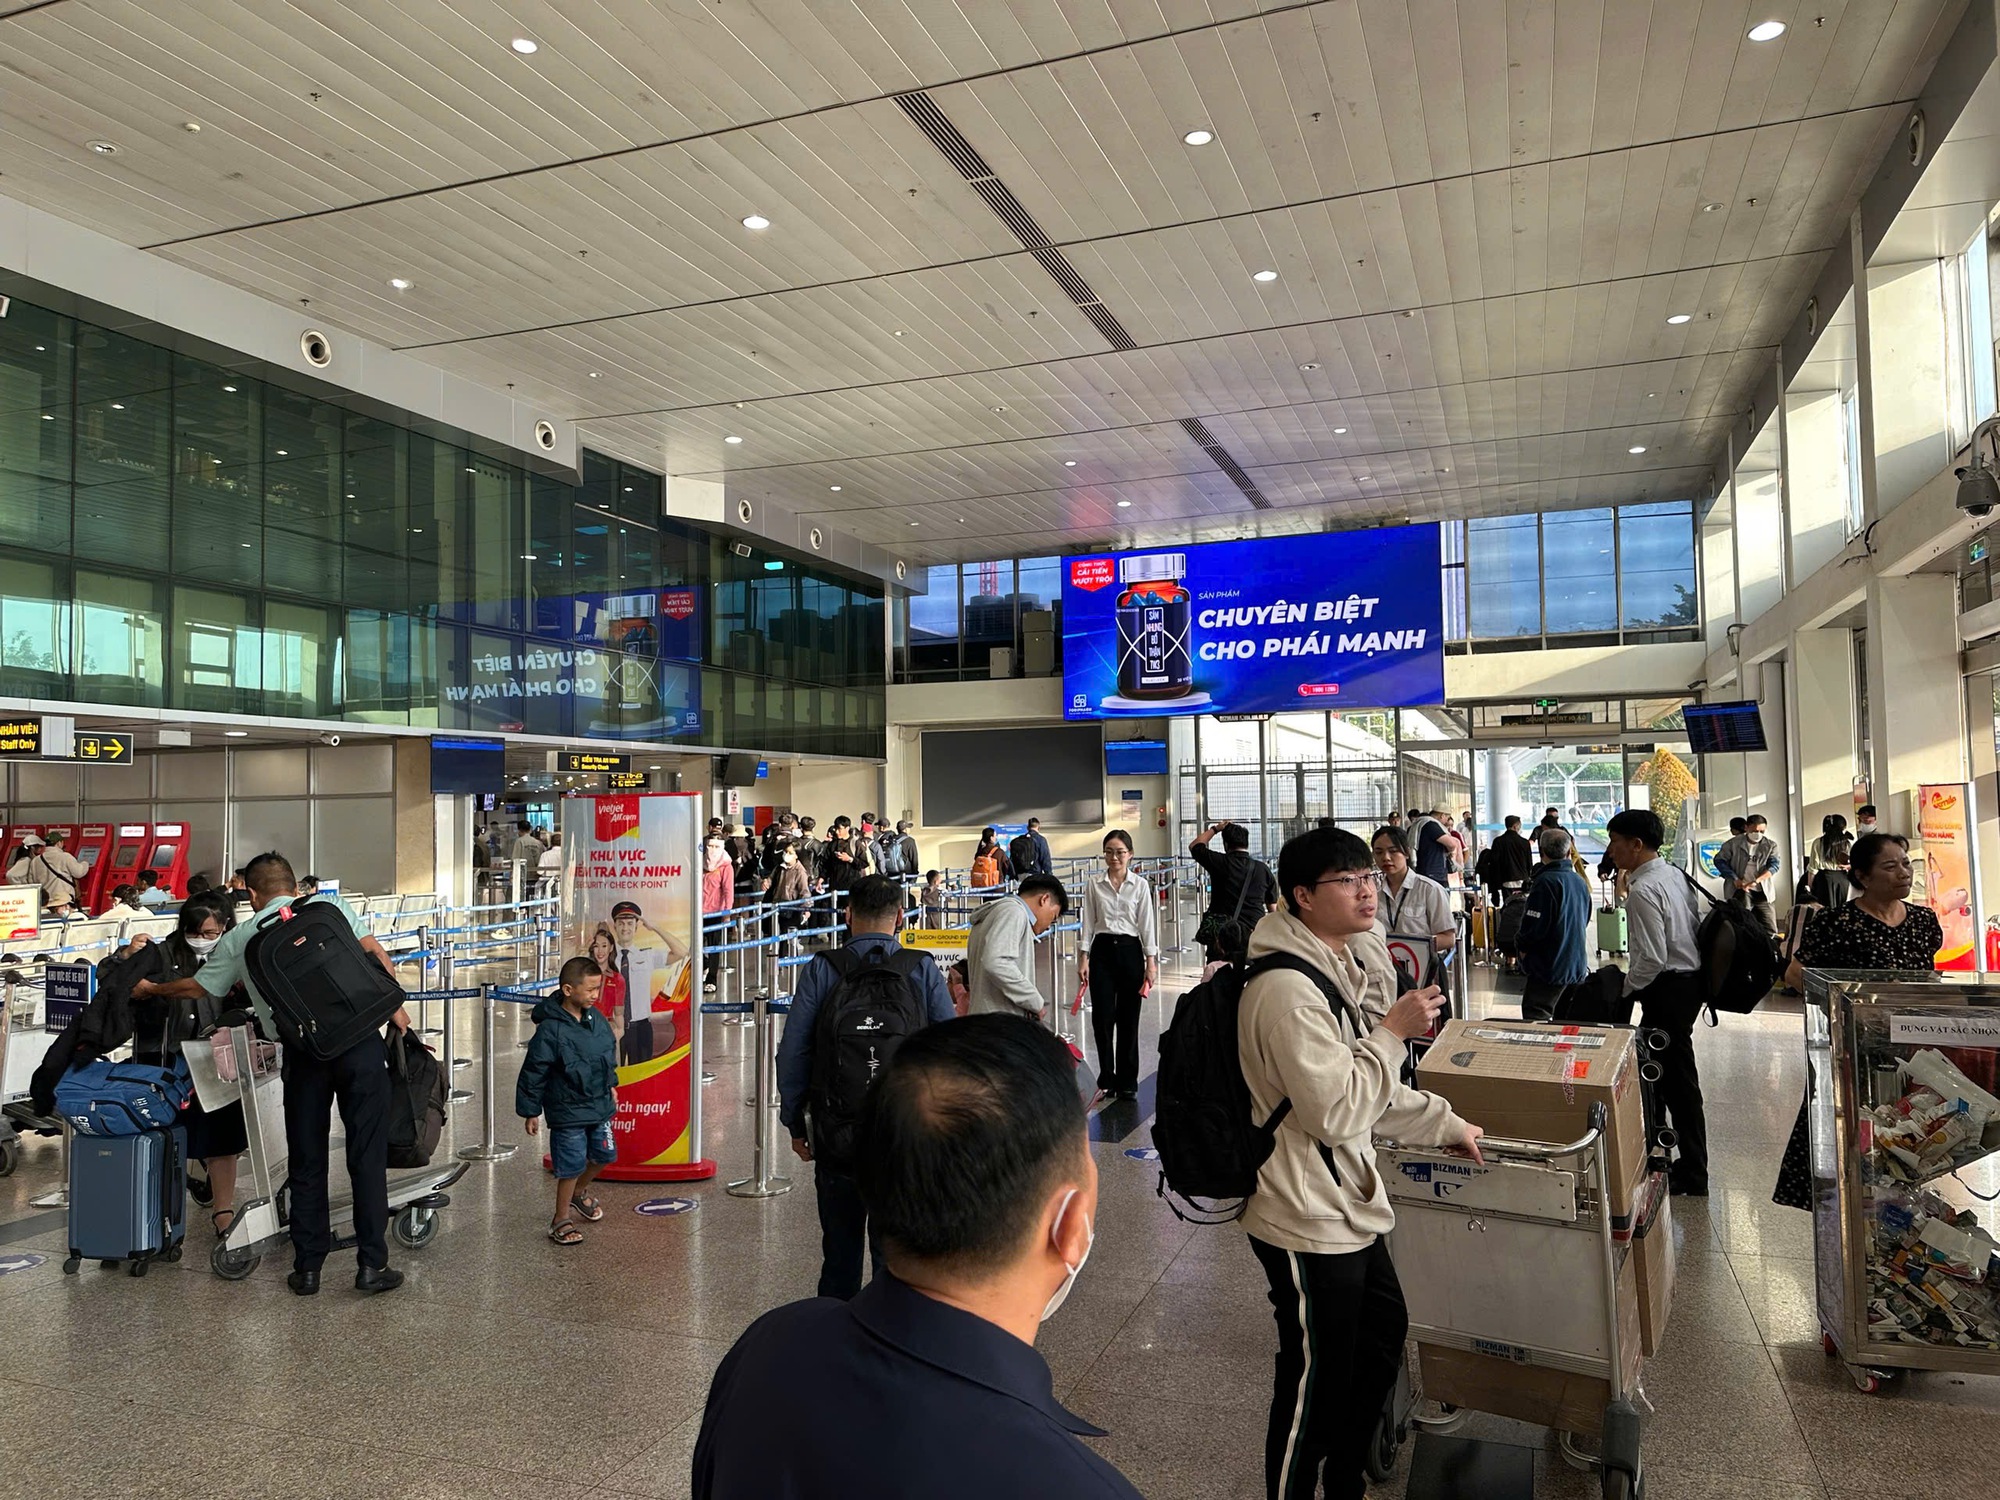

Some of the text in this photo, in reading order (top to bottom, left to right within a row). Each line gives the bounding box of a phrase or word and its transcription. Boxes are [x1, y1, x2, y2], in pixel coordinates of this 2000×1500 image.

[1092, 566, 1108, 575] TIẾN
[1096, 576, 1113, 584] TRỘI
[1198, 594, 1380, 629] CHUYÊN BIỆT
[1199, 629, 1427, 661] CHO PHÁI MẠNH
[20, 723, 39, 735] VIÊN
[1, 739, 36, 751] Staff Only
[590, 848, 646, 865] KHU VỰC
[594, 867, 617, 877] TRA
[620, 866, 640, 877] AN
[643, 865, 681, 877] NINH
[575, 881, 608, 889] SECURITY
[610, 881, 639, 889] CHECK
[944, 954, 960, 962] VỰC
[409, 990, 479, 1000] INTERNATIONAL AIRPORT
[508, 986, 521, 994] TIA
[1929, 1025, 1950, 1035] VẬT
[1971, 1027, 1999, 1036] NHỌN
[635, 1100, 672, 1116] ngay!
[1432, 1162, 1471, 1176] BIZMAN
[1475, 1340, 1510, 1354] BIZMAN
